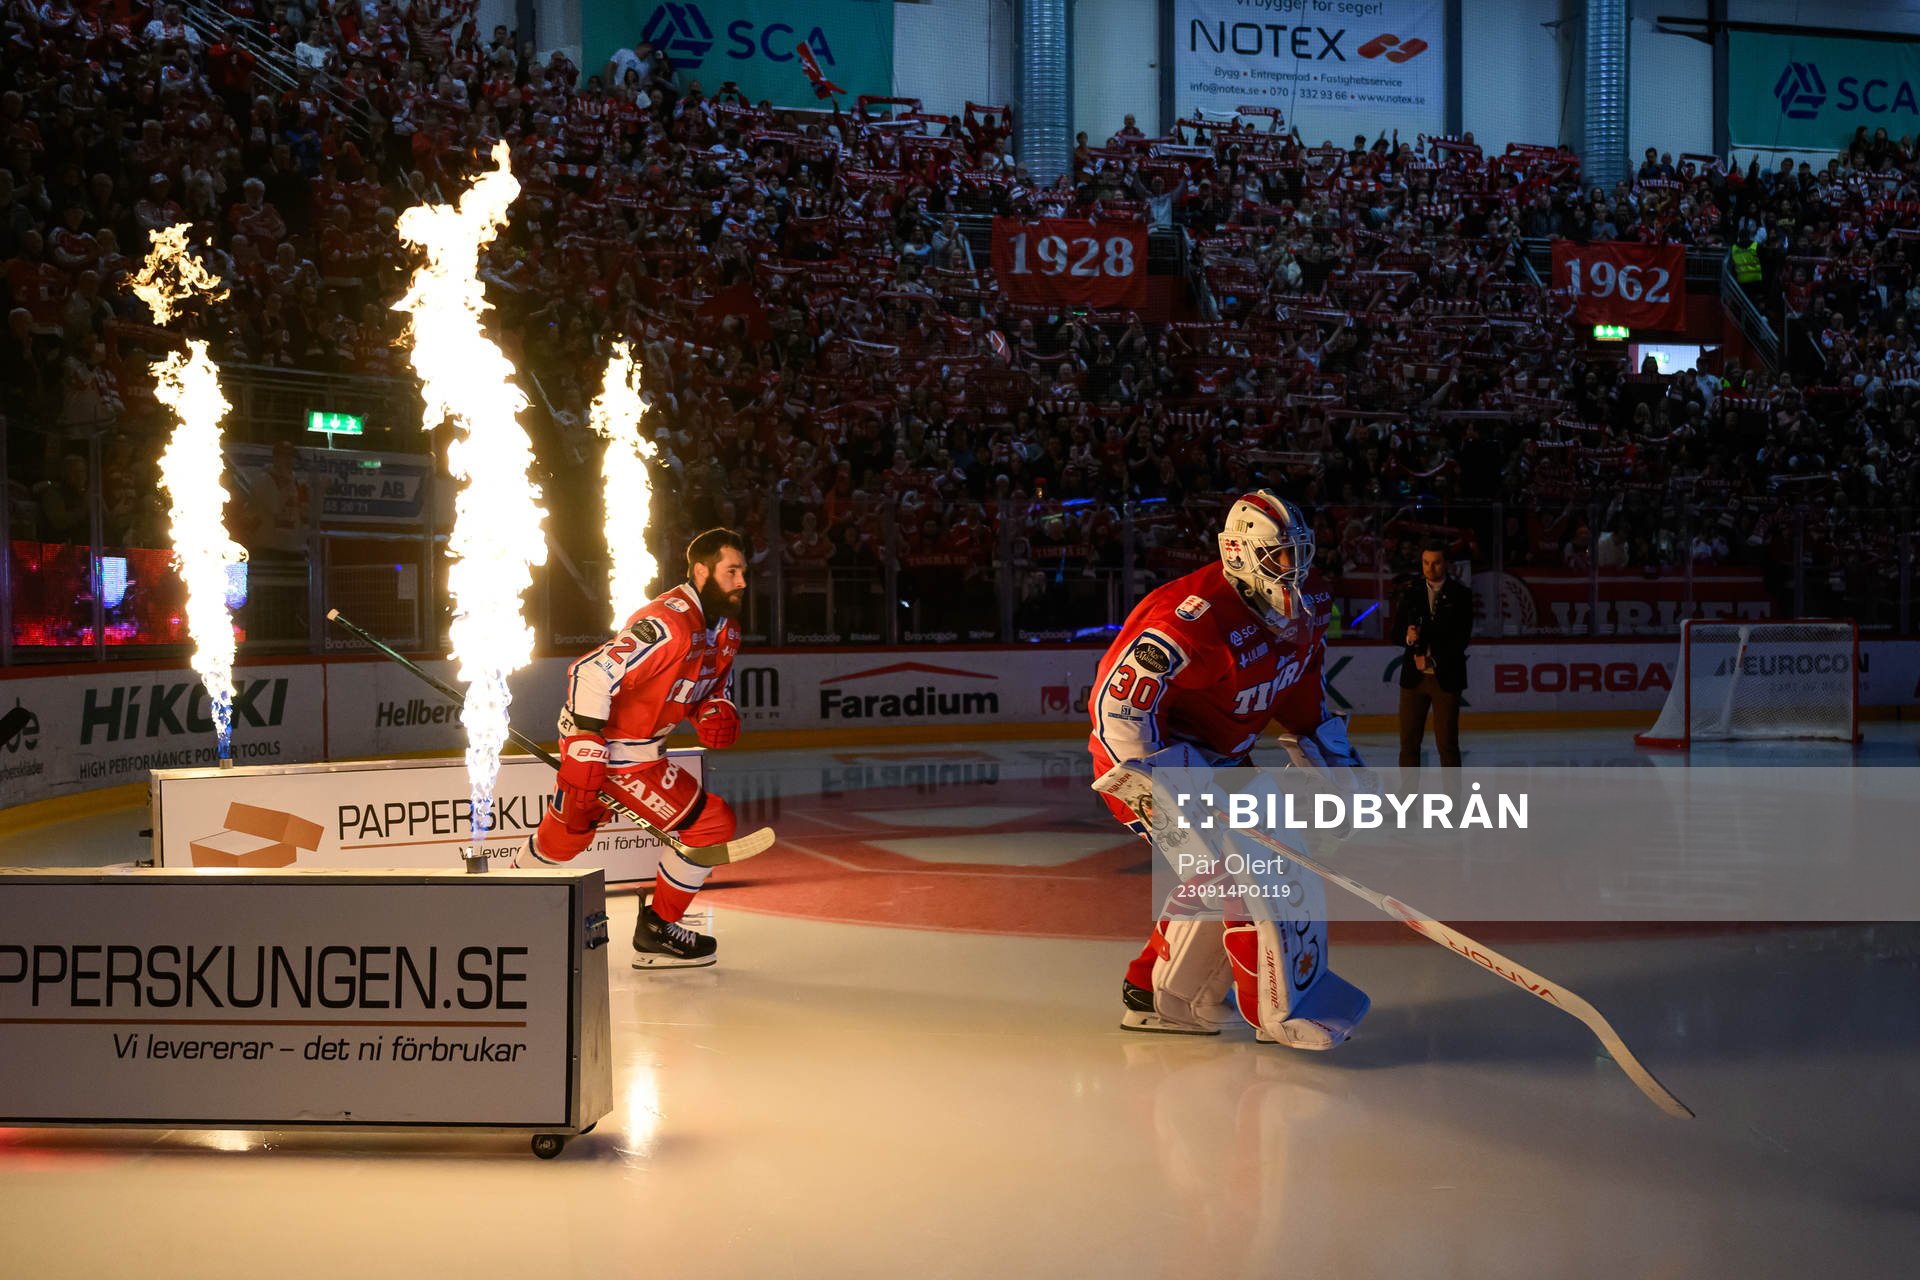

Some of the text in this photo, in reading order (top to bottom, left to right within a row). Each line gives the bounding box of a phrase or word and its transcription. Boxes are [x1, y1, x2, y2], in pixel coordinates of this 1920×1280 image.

[727, 20, 836, 65] SCA
[1190, 19, 1346, 61] NOTEX
[1190, 82, 1425, 105] info@notex.se 070 332 93 66 www.notex.se
[1214, 67, 1240, 79] Bygg
[1250, 70, 1311, 83] Entreprenad
[1836, 76, 1919, 115] SCA
[1008, 231, 1134, 278] 1928
[1564, 257, 1670, 304] 1962
[1109, 664, 1160, 711] 30
[1494, 662, 1673, 693] BORGA
[820, 686, 999, 719] Faradium
[80, 761, 106, 779] HIGH
[109, 750, 192, 776] PERFORMANCE
[241, 741, 281, 759] TOOLS
[113, 1033, 138, 1059] Vi
[147, 1033, 274, 1060] levererar
[304, 1035, 350, 1060] det
[359, 1035, 383, 1061] ni
[392, 1035, 527, 1062] förbrukar
